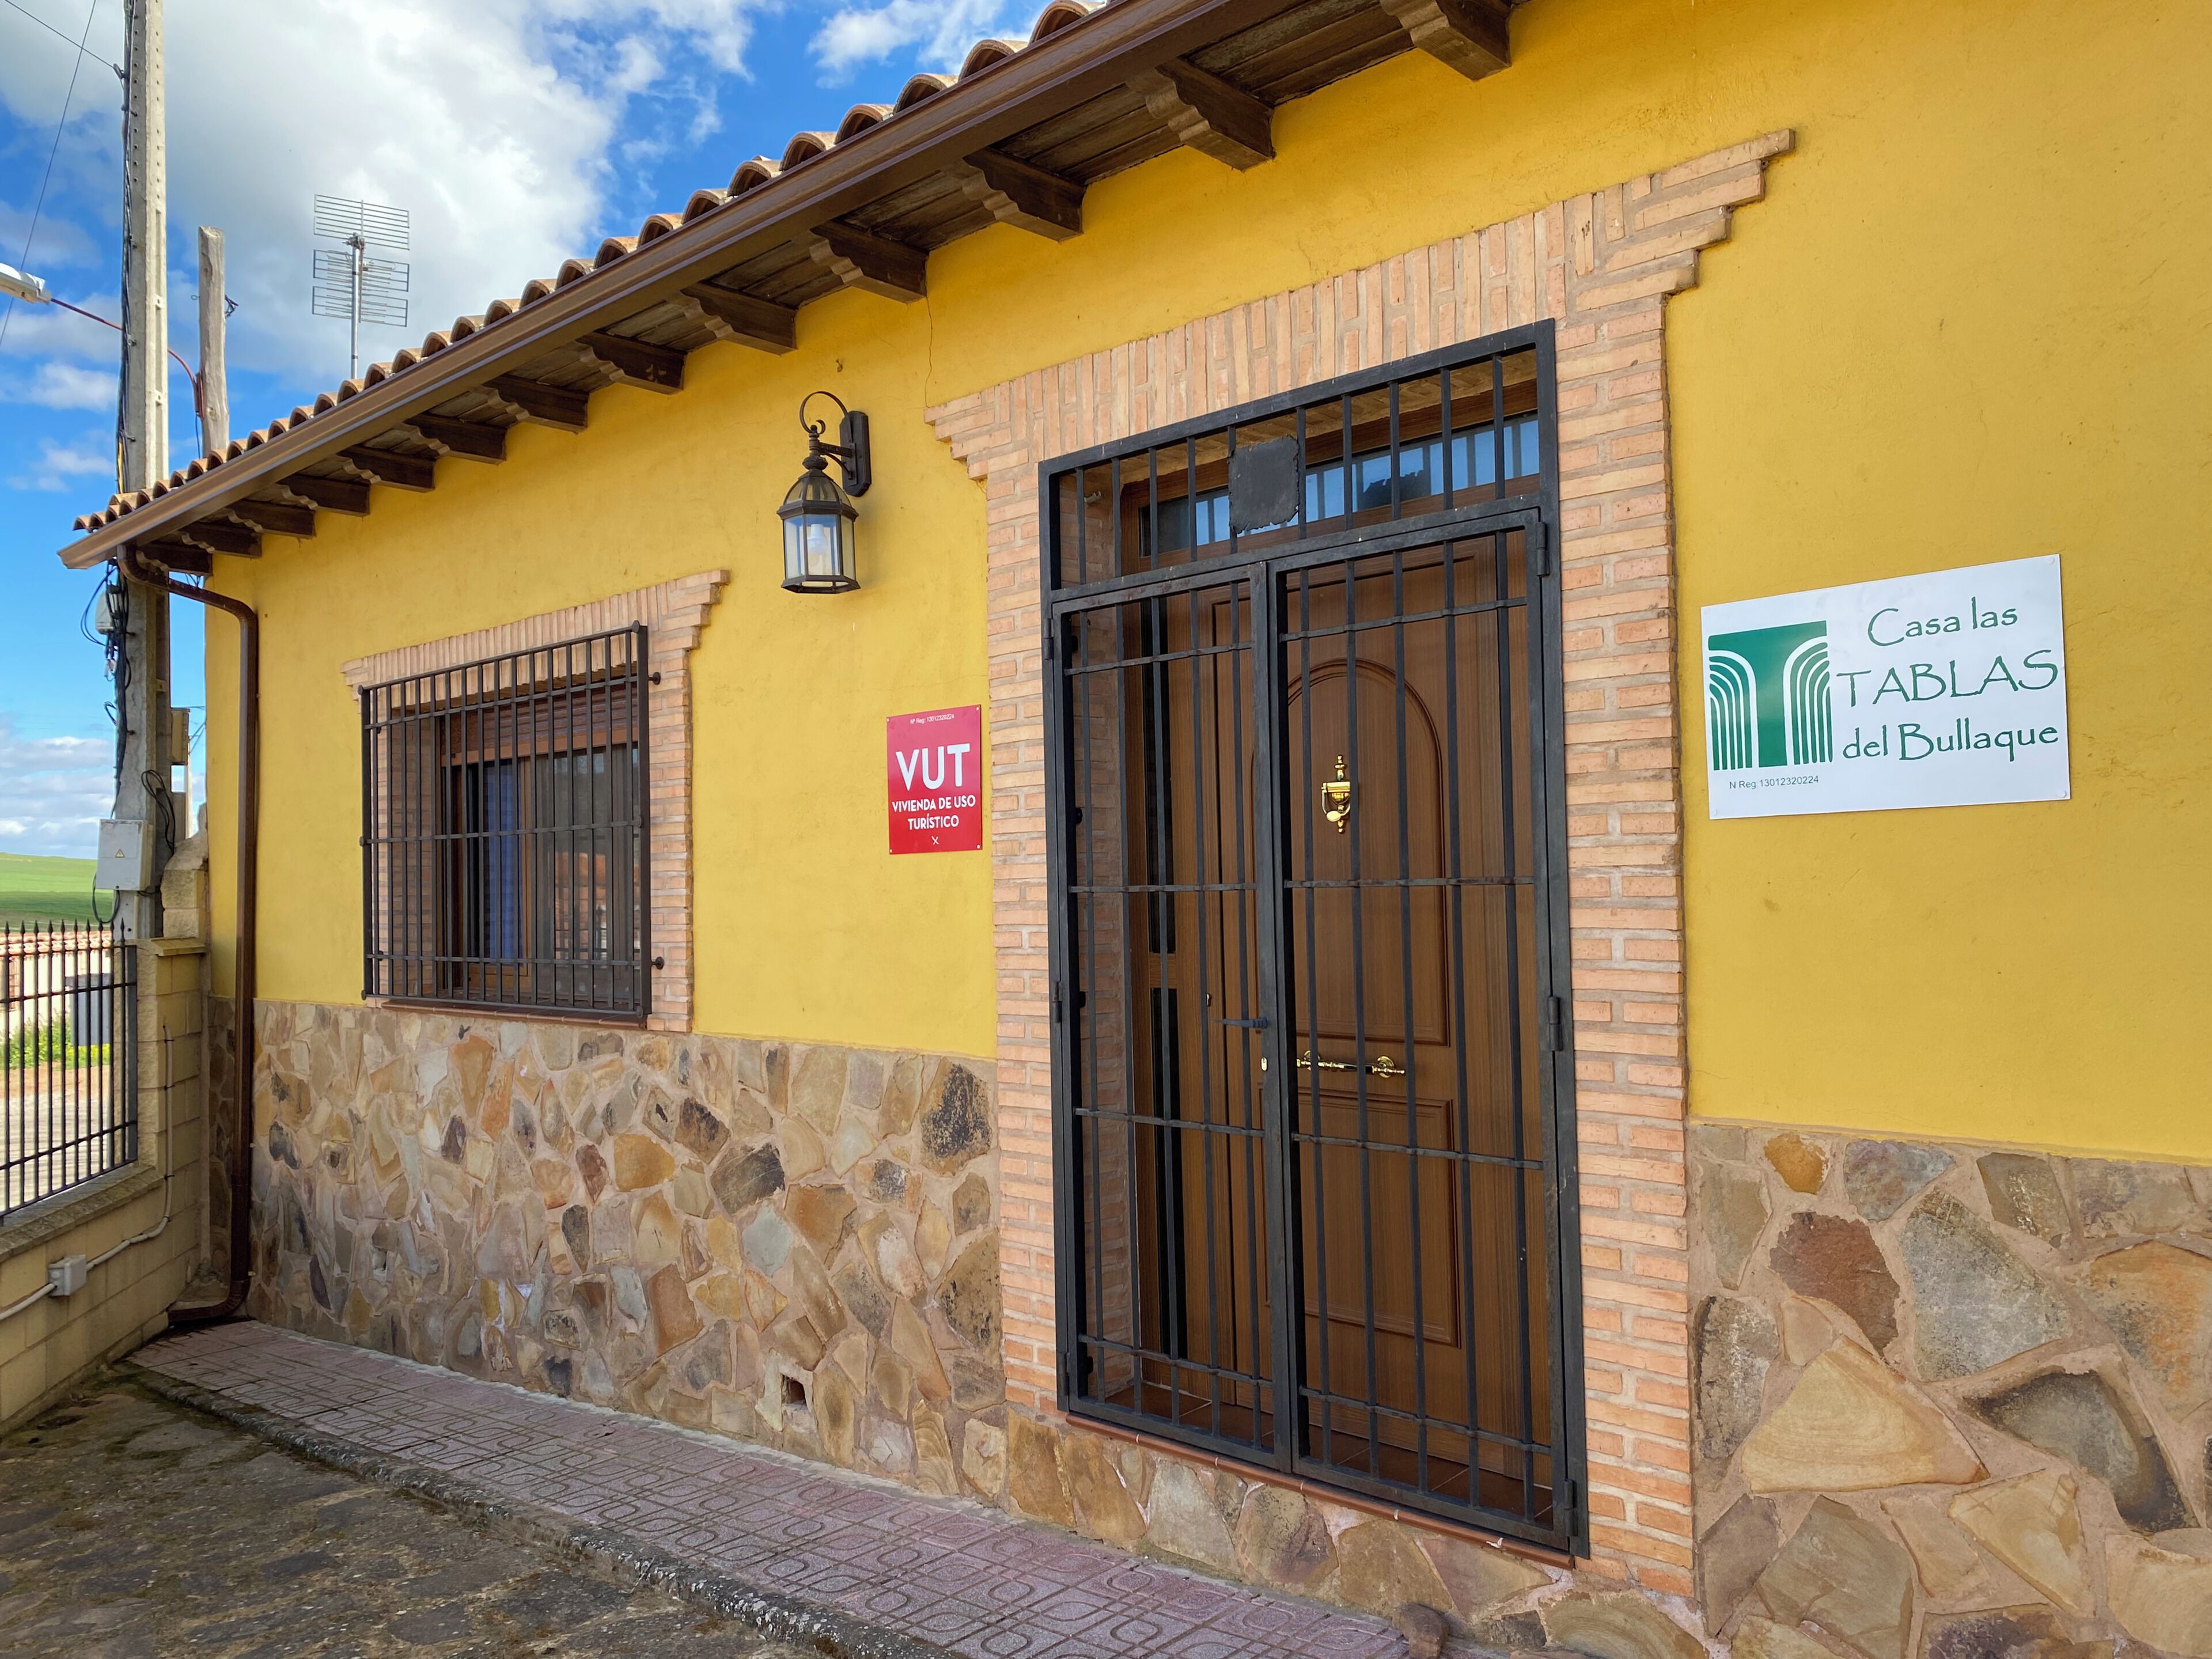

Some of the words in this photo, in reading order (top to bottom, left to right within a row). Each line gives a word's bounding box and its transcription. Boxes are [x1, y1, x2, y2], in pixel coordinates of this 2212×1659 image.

[1868, 608, 1961, 647] Casa
[1971, 596, 2018, 630] las
[1836, 649, 2059, 707] TABLAS
[1843, 725, 1888, 759] del
[1898, 717, 2059, 762] Bullaque
[895, 743, 970, 791] VUT
[1759, 775, 1819, 787] 13012320224
[892, 798, 936, 812] VIVIENDA
[938, 797, 952, 809] DE
[954, 794, 976, 808] USO
[907, 813, 959, 830] TURÍSTICO
